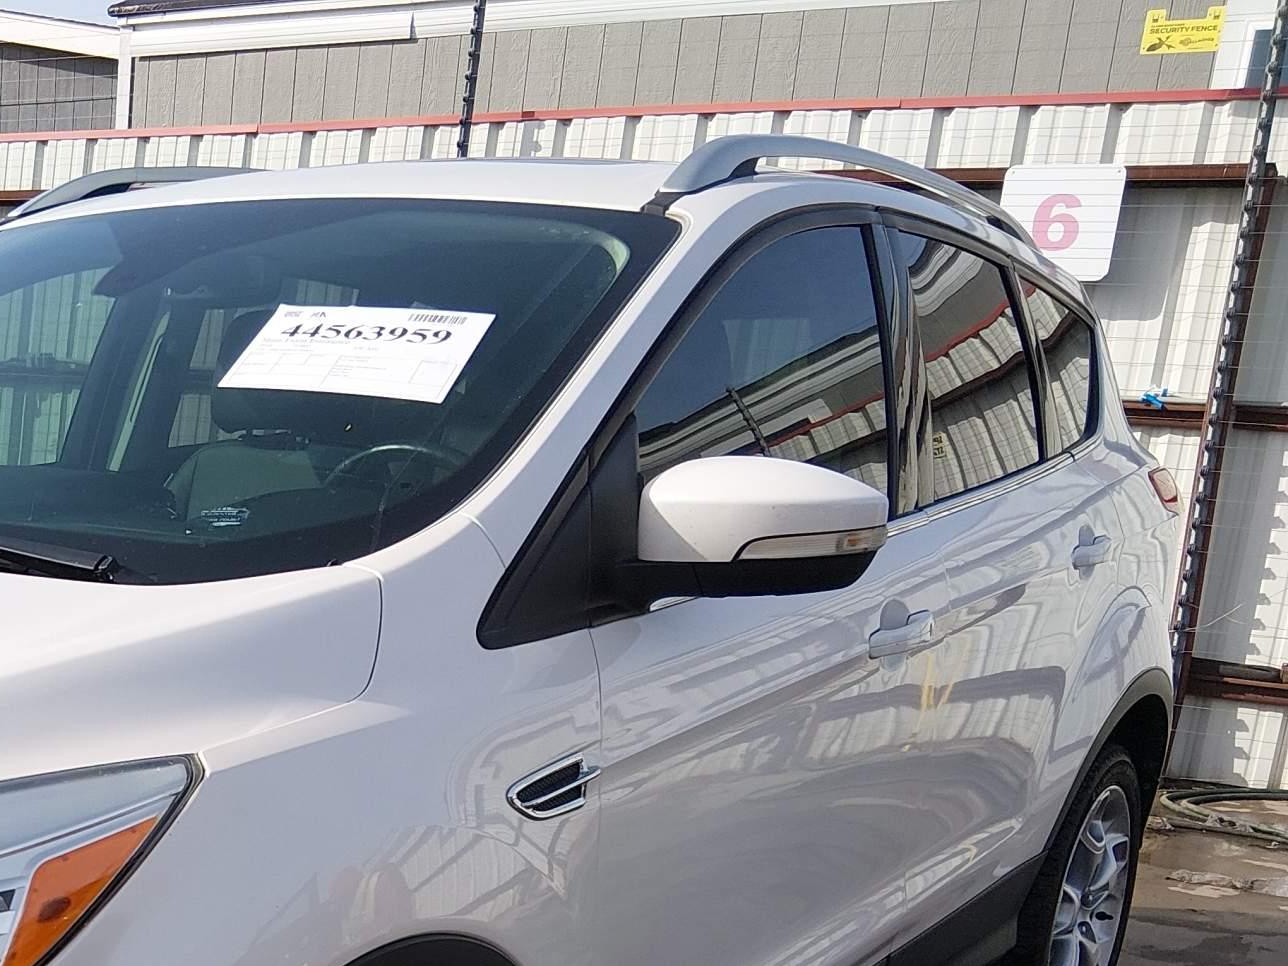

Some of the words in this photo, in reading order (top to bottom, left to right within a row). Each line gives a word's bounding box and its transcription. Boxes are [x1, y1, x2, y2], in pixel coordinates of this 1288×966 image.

[1150, 26, 1190, 35] SECURITY
[1032, 193, 1082, 251] 6
[281, 323, 452, 344] 44563959
